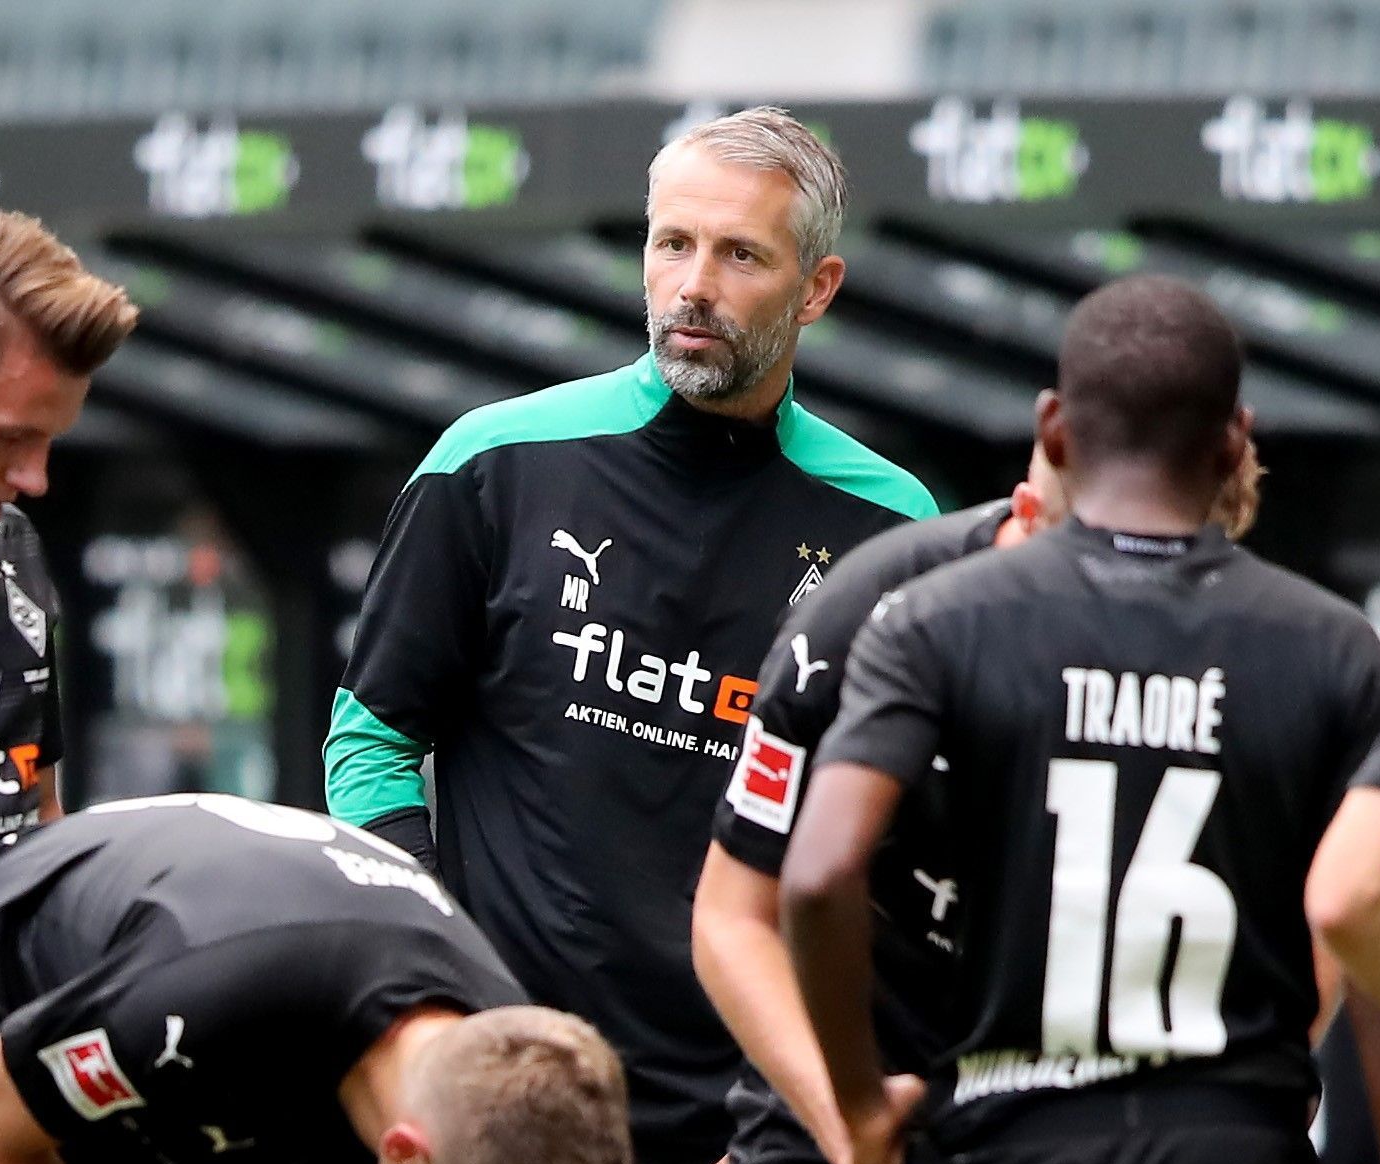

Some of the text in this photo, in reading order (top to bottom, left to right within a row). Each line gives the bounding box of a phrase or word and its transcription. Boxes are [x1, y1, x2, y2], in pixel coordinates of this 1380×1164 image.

[560, 574, 590, 612] MR
[564, 703, 629, 734] AKTIEN.
[632, 721, 699, 752] ONLINE.
[1062, 666, 1226, 755] TRAORÉ
[1041, 757, 1239, 1058] 16
